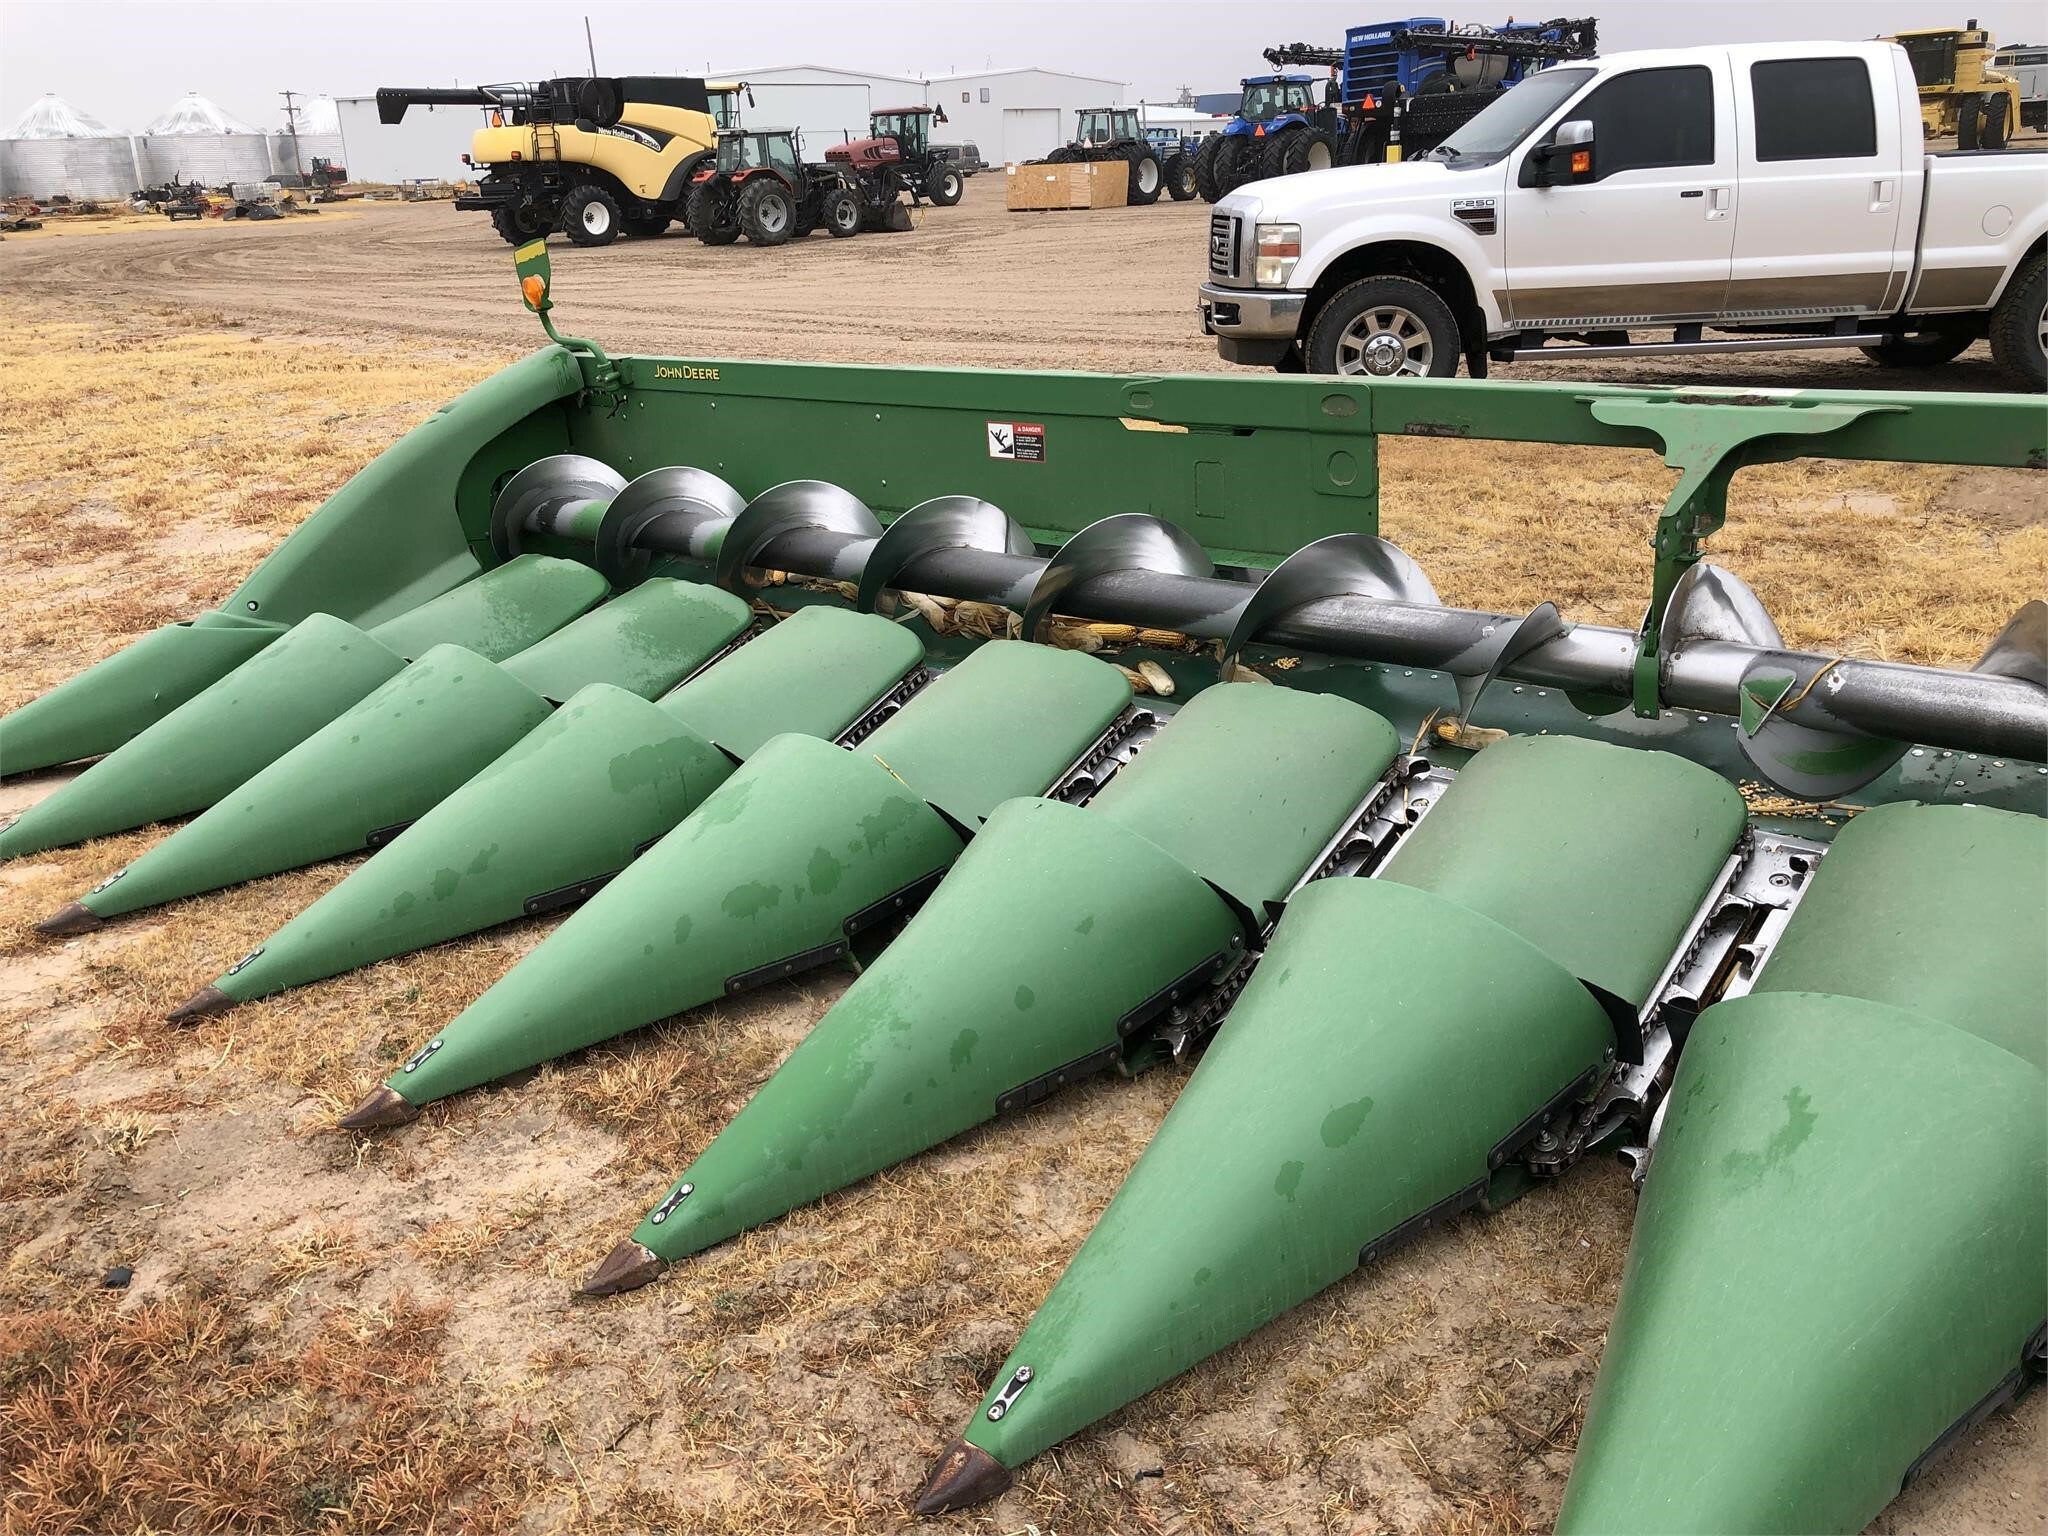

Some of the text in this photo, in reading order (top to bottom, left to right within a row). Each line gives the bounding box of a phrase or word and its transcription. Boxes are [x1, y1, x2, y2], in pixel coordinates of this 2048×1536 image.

[1351, 31, 1391, 43] NEW HOLLAND
[598, 127, 636, 141] New Holland
[1453, 199, 1495, 208] F-250
[654, 364, 720, 380] JOHN DEERE
